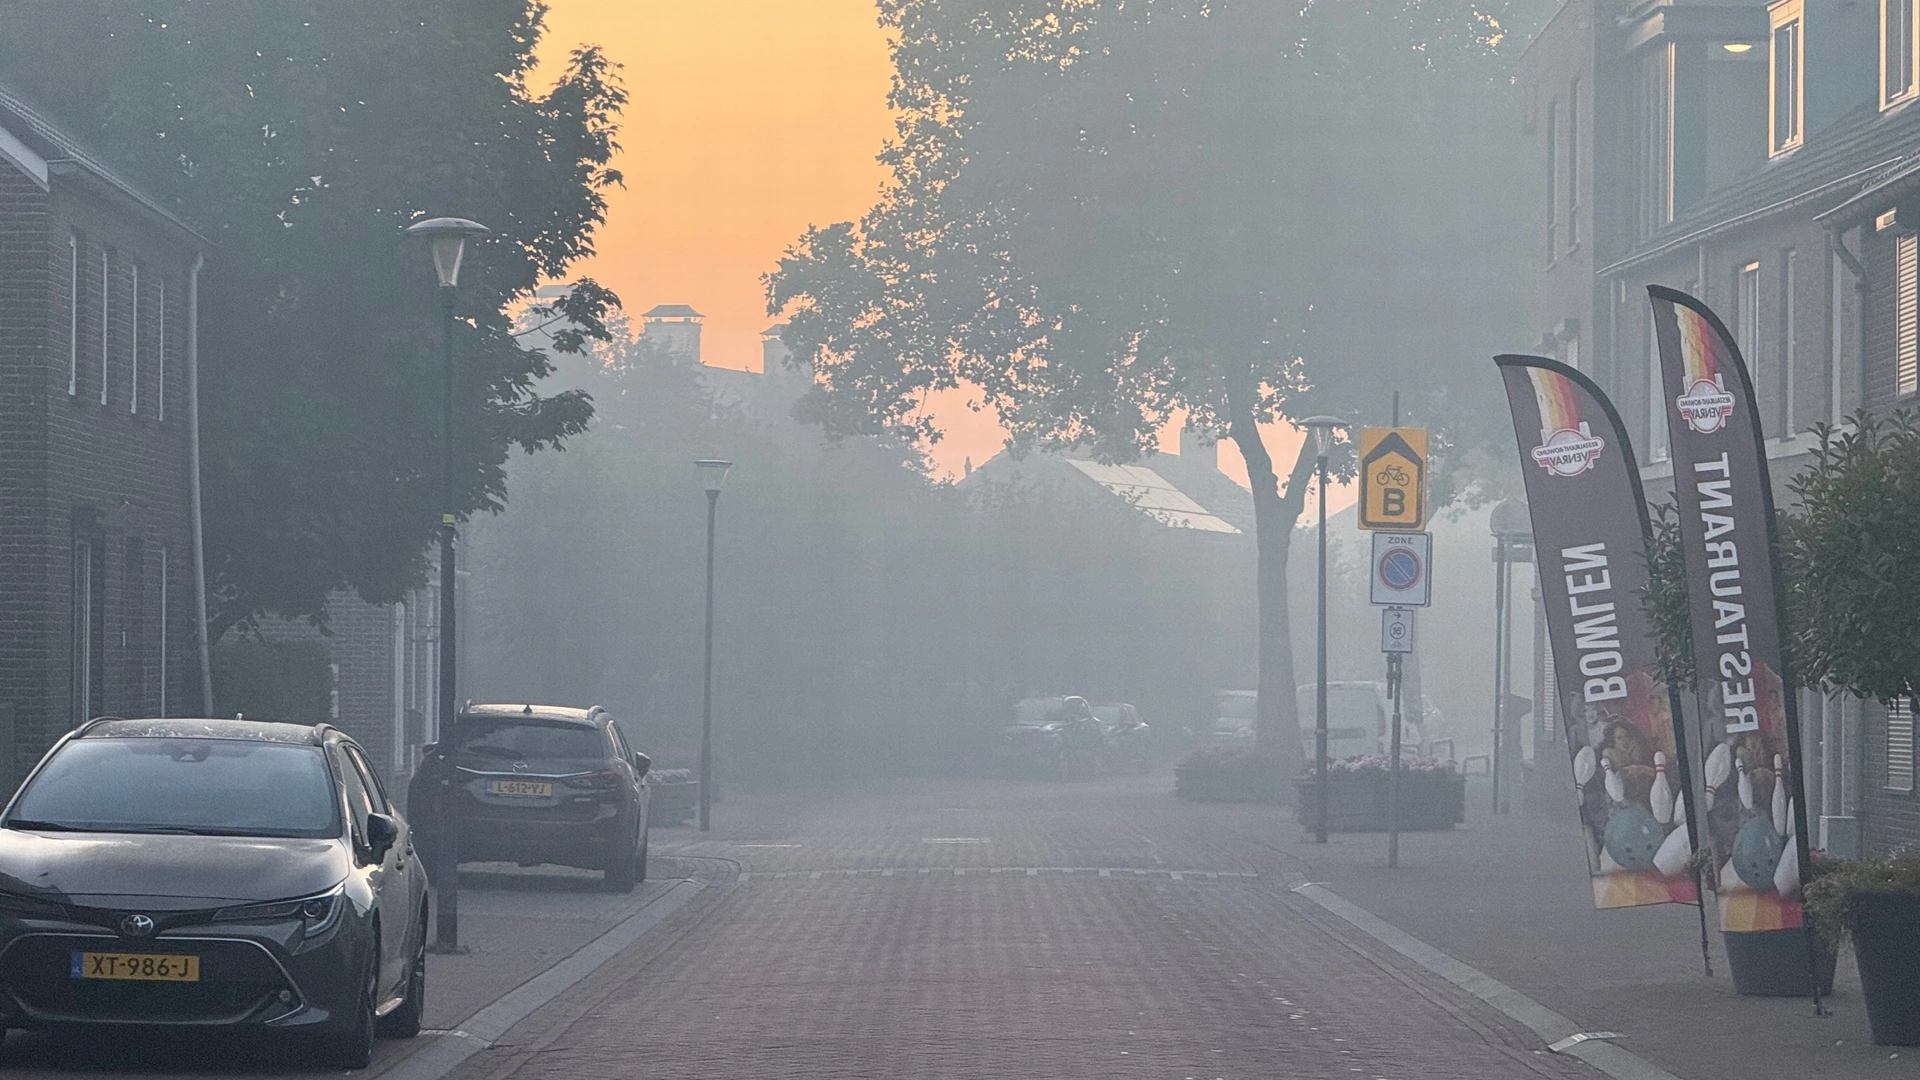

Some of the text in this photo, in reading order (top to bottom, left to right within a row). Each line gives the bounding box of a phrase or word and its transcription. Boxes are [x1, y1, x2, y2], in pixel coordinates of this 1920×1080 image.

[1382, 487, 1406, 516] B
[1388, 536, 1414, 545] ZONE
[91, 955, 189, 978] XT-986-J
